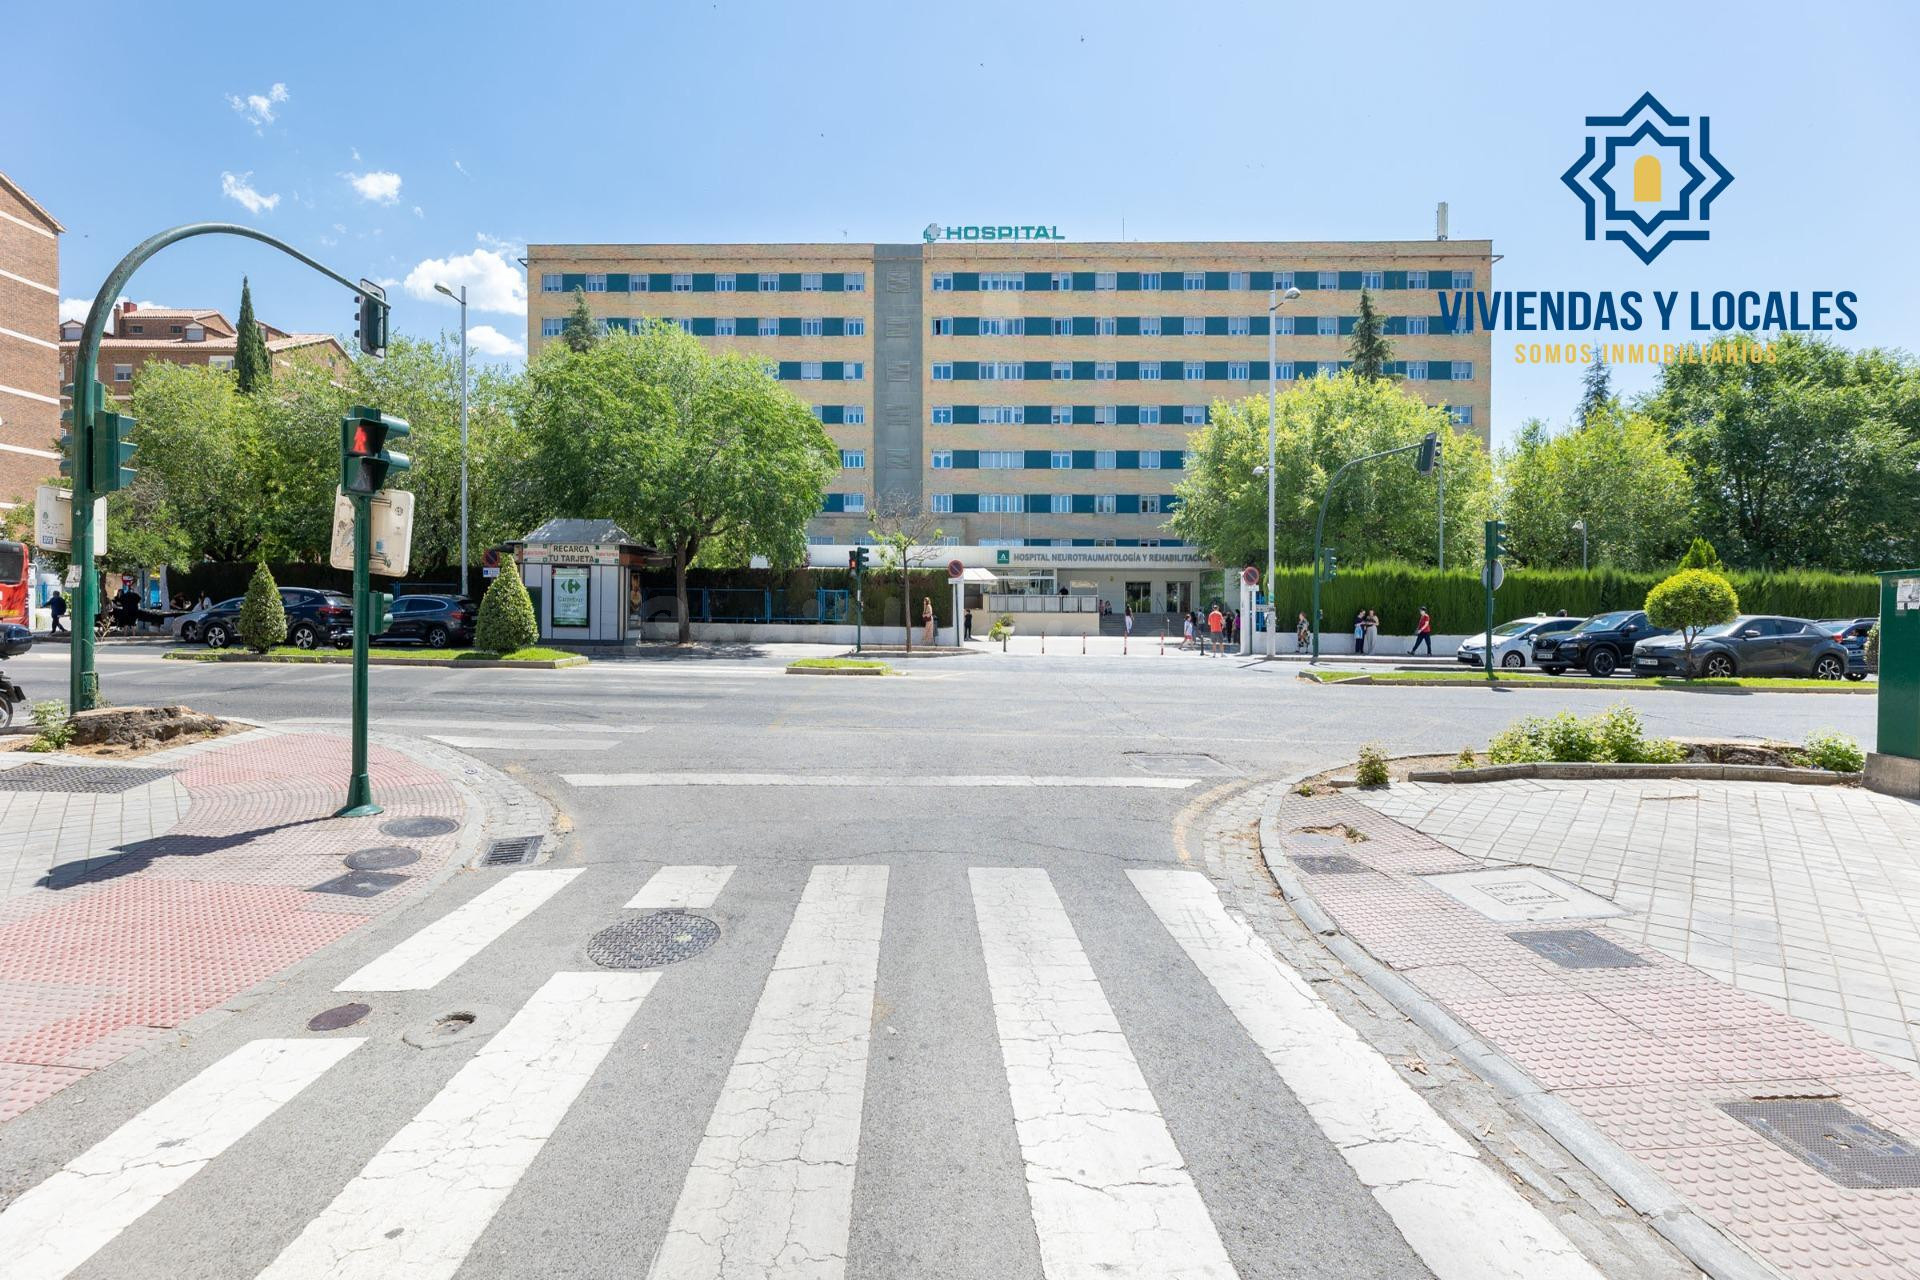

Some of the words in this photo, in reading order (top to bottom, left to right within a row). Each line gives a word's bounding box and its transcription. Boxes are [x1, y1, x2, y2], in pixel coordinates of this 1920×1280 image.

[946, 225, 1066, 240] HOSPITAL
[553, 545, 590, 553] RECARGA
[548, 554, 559, 562] TU
[561, 554, 595, 563] TARJETA
[1013, 553, 1050, 562] HOSPITAL
[1051, 552, 1141, 562] NEUROTRAUMATOLOGÍA
[1142, 553, 1148, 562] Y
